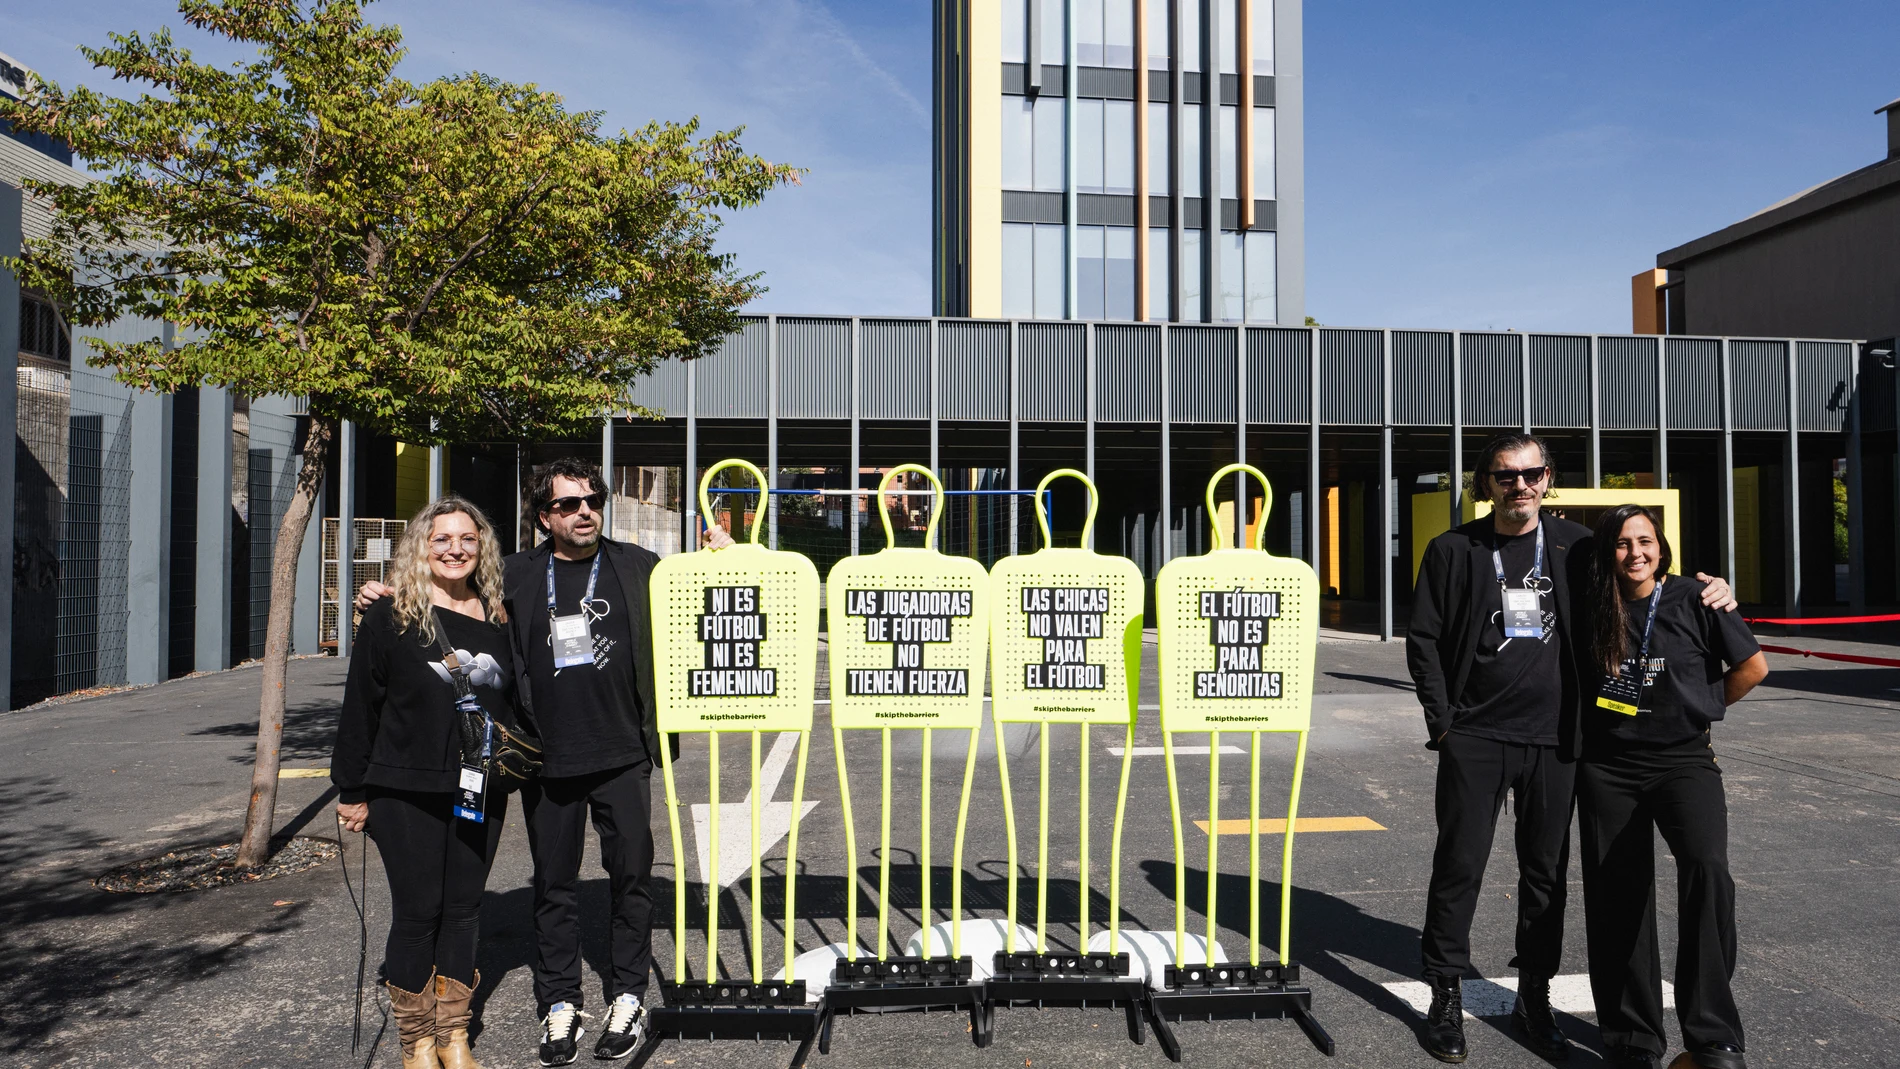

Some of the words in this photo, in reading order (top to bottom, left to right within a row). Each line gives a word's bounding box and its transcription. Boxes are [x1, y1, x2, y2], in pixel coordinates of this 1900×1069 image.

[712, 588, 729, 612] NI
[735, 588, 754, 612] ES
[848, 591, 876, 614] LAS
[880, 591, 970, 615] JUGADORAS
[1023, 588, 1050, 612] LAS
[1054, 588, 1108, 612] CHICAS
[1201, 593, 1218, 617] EL
[1223, 588, 1280, 617] FÚTBOL
[704, 609, 763, 640] FÚTBOL
[868, 618, 888, 641] DE
[892, 613, 950, 642] FÚTBOL
[1030, 614, 1050, 637] NO
[1054, 614, 1100, 637] VALEN
[1542, 612, 1554, 622] YOU
[598, 636, 608, 648] YOU
[1218, 620, 1239, 644] NO
[1244, 620, 1262, 644] ES
[604, 644, 610, 652] OF
[712, 642, 729, 668] NI
[735, 642, 754, 668] ES
[898, 644, 919, 668] NO
[1046, 640, 1085, 662] PARA
[1220, 646, 1260, 670] PARA
[1027, 664, 1044, 688] EL
[1048, 660, 1104, 688] FÚTBOL
[1648, 658, 1665, 672] NOT
[693, 670, 774, 695] FEMENINO
[849, 670, 904, 694] TIENEN
[908, 670, 966, 694] FUERZA
[1197, 668, 1280, 697] SEÑORITAS
[1607, 700, 1626, 712] Speaker
